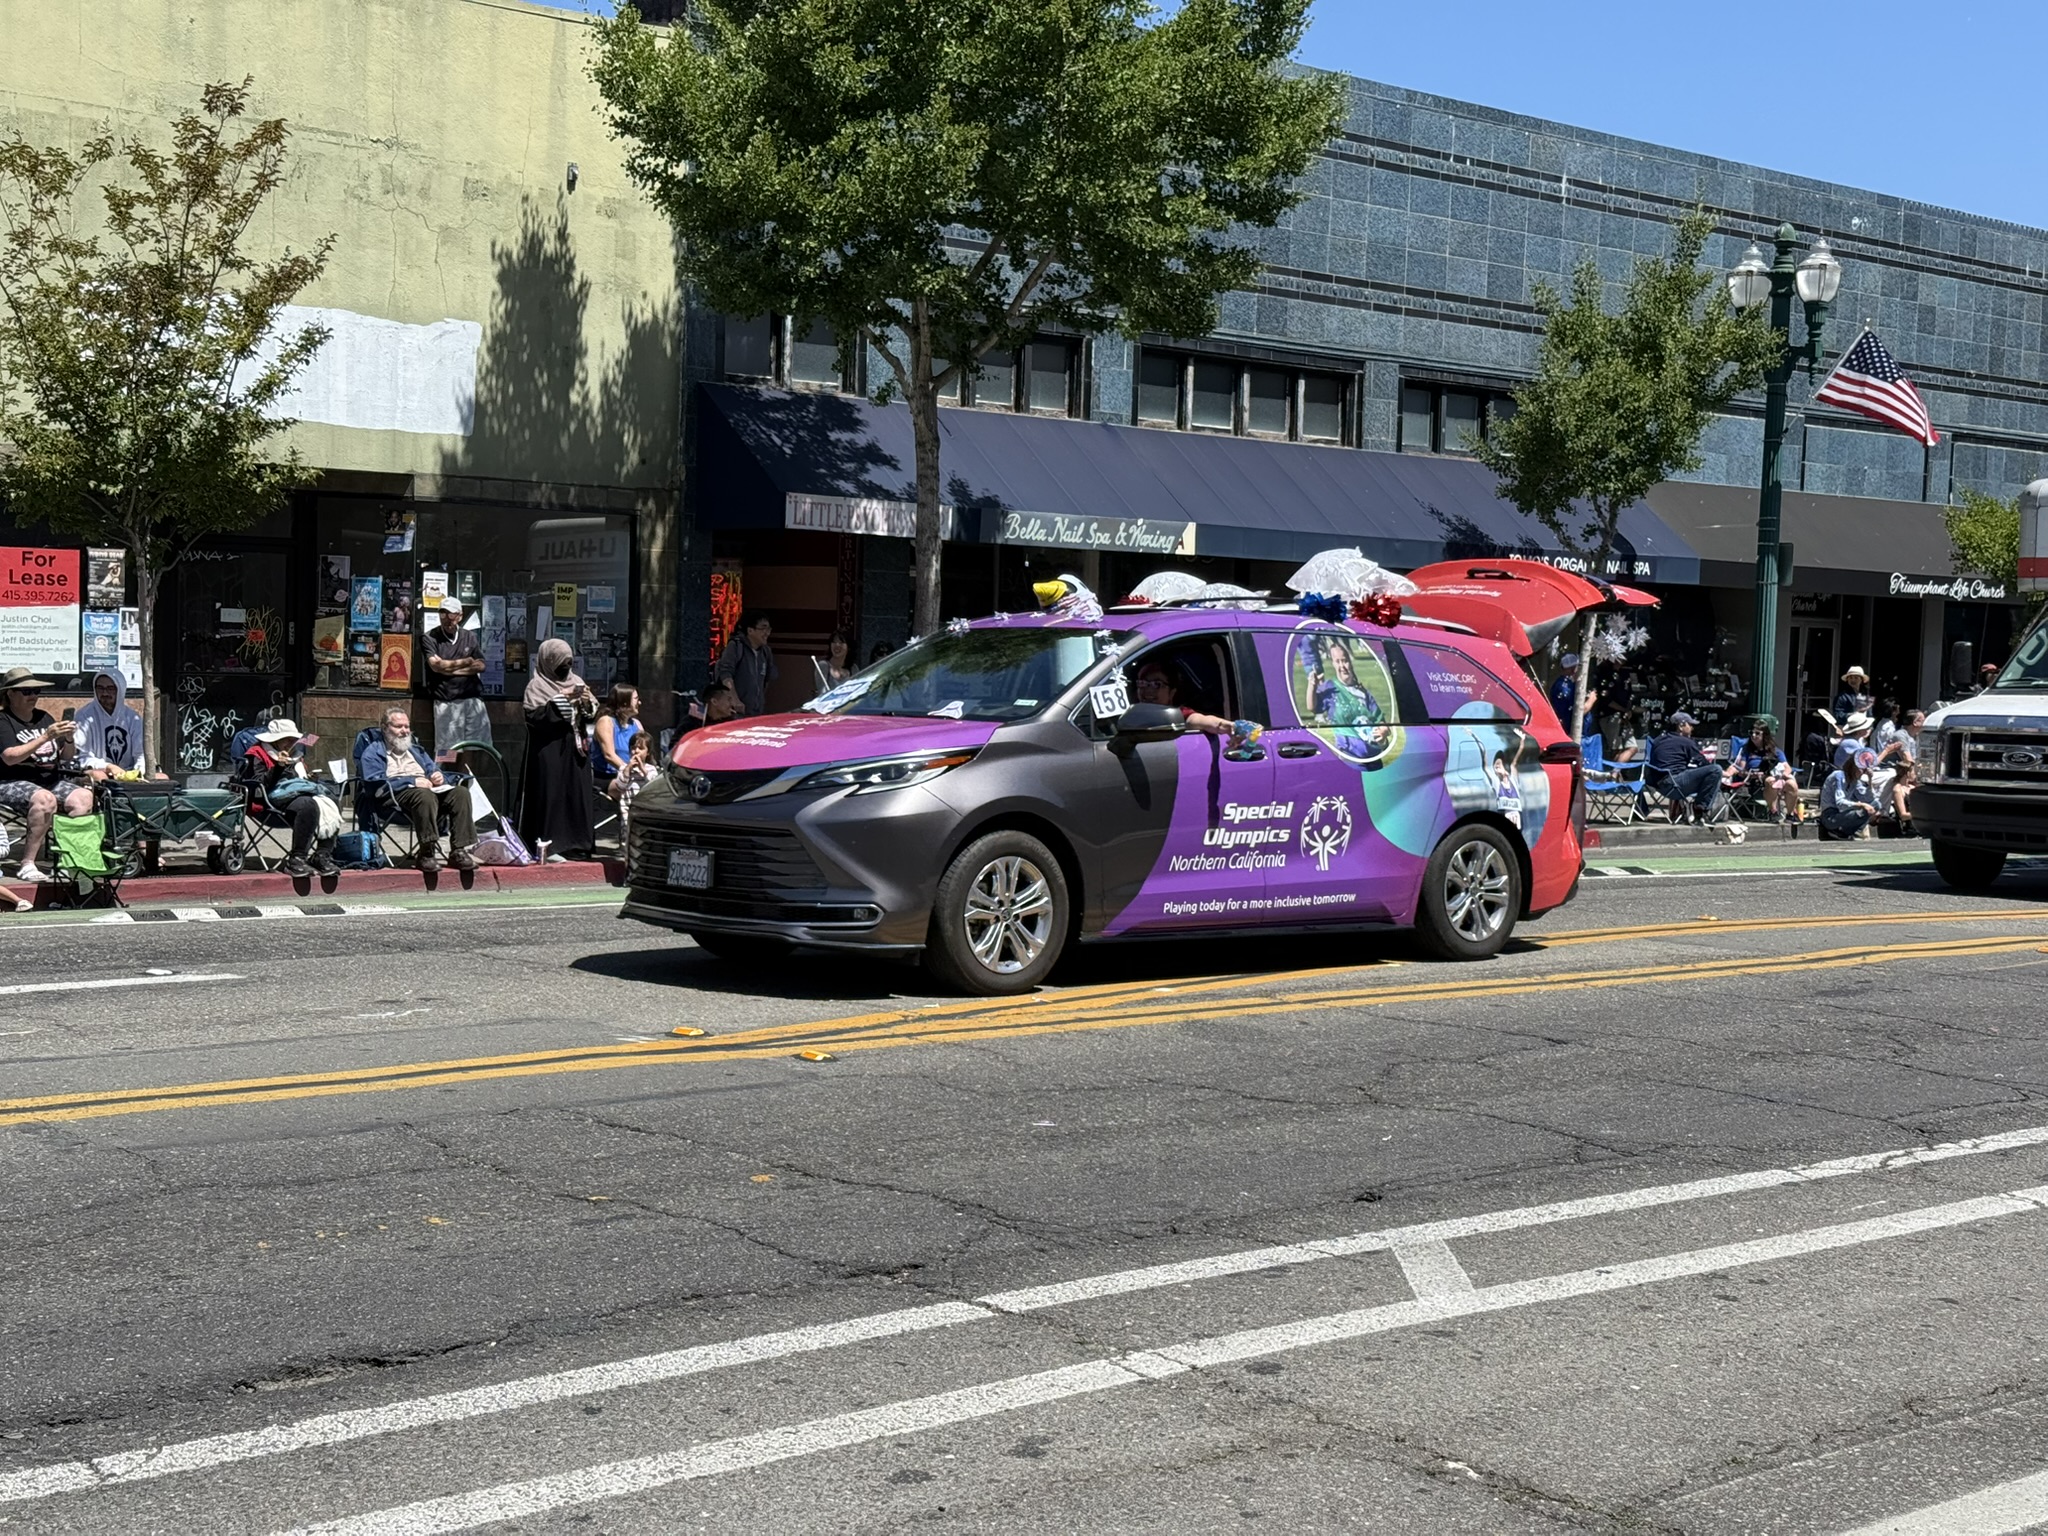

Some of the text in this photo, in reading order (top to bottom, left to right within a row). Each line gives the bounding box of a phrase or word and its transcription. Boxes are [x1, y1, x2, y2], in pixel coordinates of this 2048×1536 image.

[1004, 513, 1175, 553] Bella Nail Spa & Waxing
[21, 551, 57, 567] For
[1606, 560, 1628, 575] NAIL
[1633, 561, 1650, 576] SPA
[9, 569, 68, 586] Lease
[557, 586, 574, 594] IMP
[1890, 572, 2005, 601] Triumphant Life Church
[2, 589, 75, 602] 415.395.7262
[557, 594, 572, 602] ROV
[1, 615, 52, 623] Justin Choi
[20, 637, 69, 645] Badstubner
[64, 662, 77, 670] JLL
[1427, 671, 1477, 684] Visit SONC.ORG
[1430, 683, 1473, 694] to learn more
[1093, 688, 1127, 714] 158
[1693, 699, 1729, 710] Wednesday
[1707, 712, 1718, 722] pm
[1223, 801, 1294, 824] Special
[1203, 827, 1291, 849] Olympics
[1169, 851, 1286, 873] Northern California
[1163, 900, 1198, 915] Playing
[1200, 898, 1226, 913] today
[1226, 897, 1240, 911] for
[1249, 899, 1272, 909] more
[1274, 895, 1312, 908] inclusive
[1313, 892, 1357, 905] tomorrow
